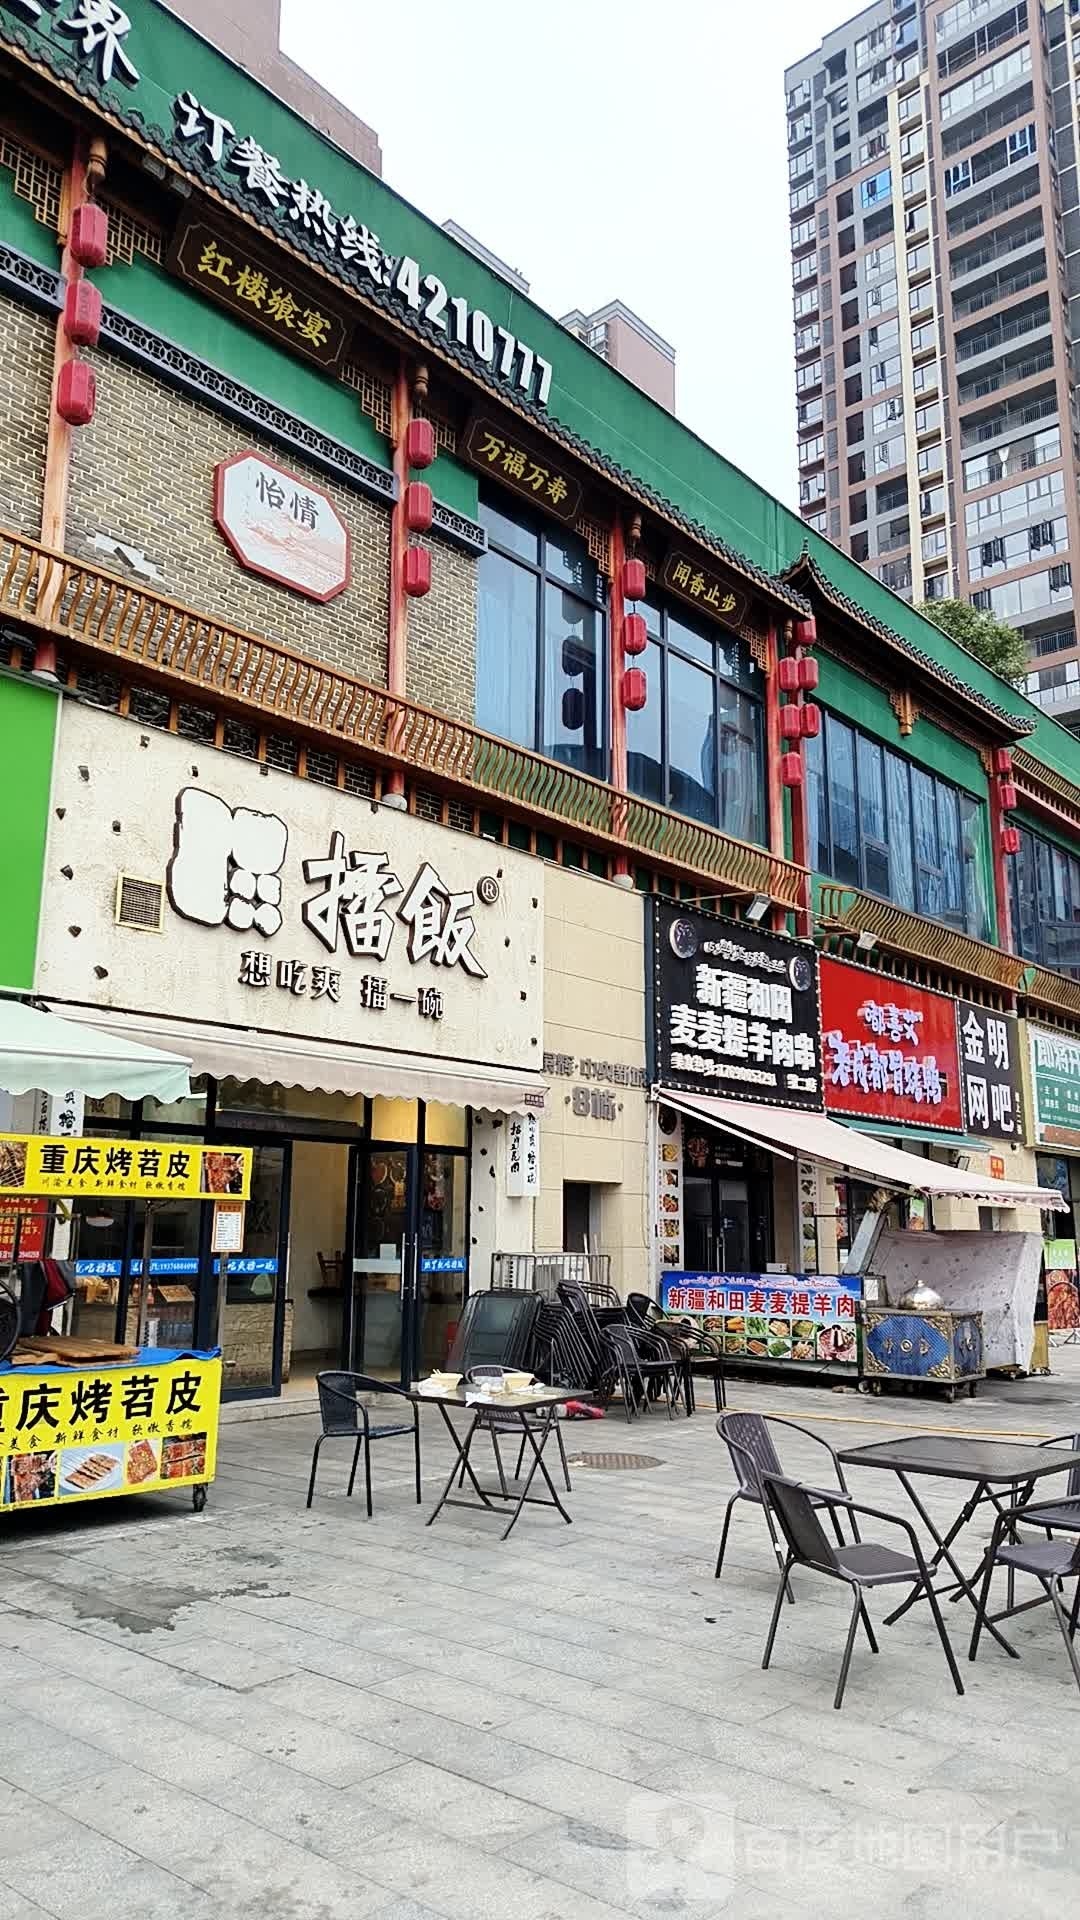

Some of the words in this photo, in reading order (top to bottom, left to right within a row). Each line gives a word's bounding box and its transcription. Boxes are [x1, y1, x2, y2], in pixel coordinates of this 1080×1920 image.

[0, 0, 140, 88] 界
[172, 90, 552, 404] 订餐热线:4210777
[477, 432, 568, 504] 万福万寿
[256, 471, 319, 530] 怡情
[672, 560, 737, 613] 闻香止步
[238, 950, 342, 1002] 想吃爽
[360, 974, 446, 1019] 擂一碗
[695, 963, 793, 1023] 新疆和田
[669, 1003, 816, 1070] 麦麦提羊肉串
[962, 1010, 1009, 1070] 金明
[966, 1073, 1015, 1133] 网吧
[39, 1144, 191, 1180] 重庆烤苕皮
[668, 1287, 856, 1318] 新疆和田麦麦提羊肉
[55, 1428, 120, 1444] 新鲜食材
